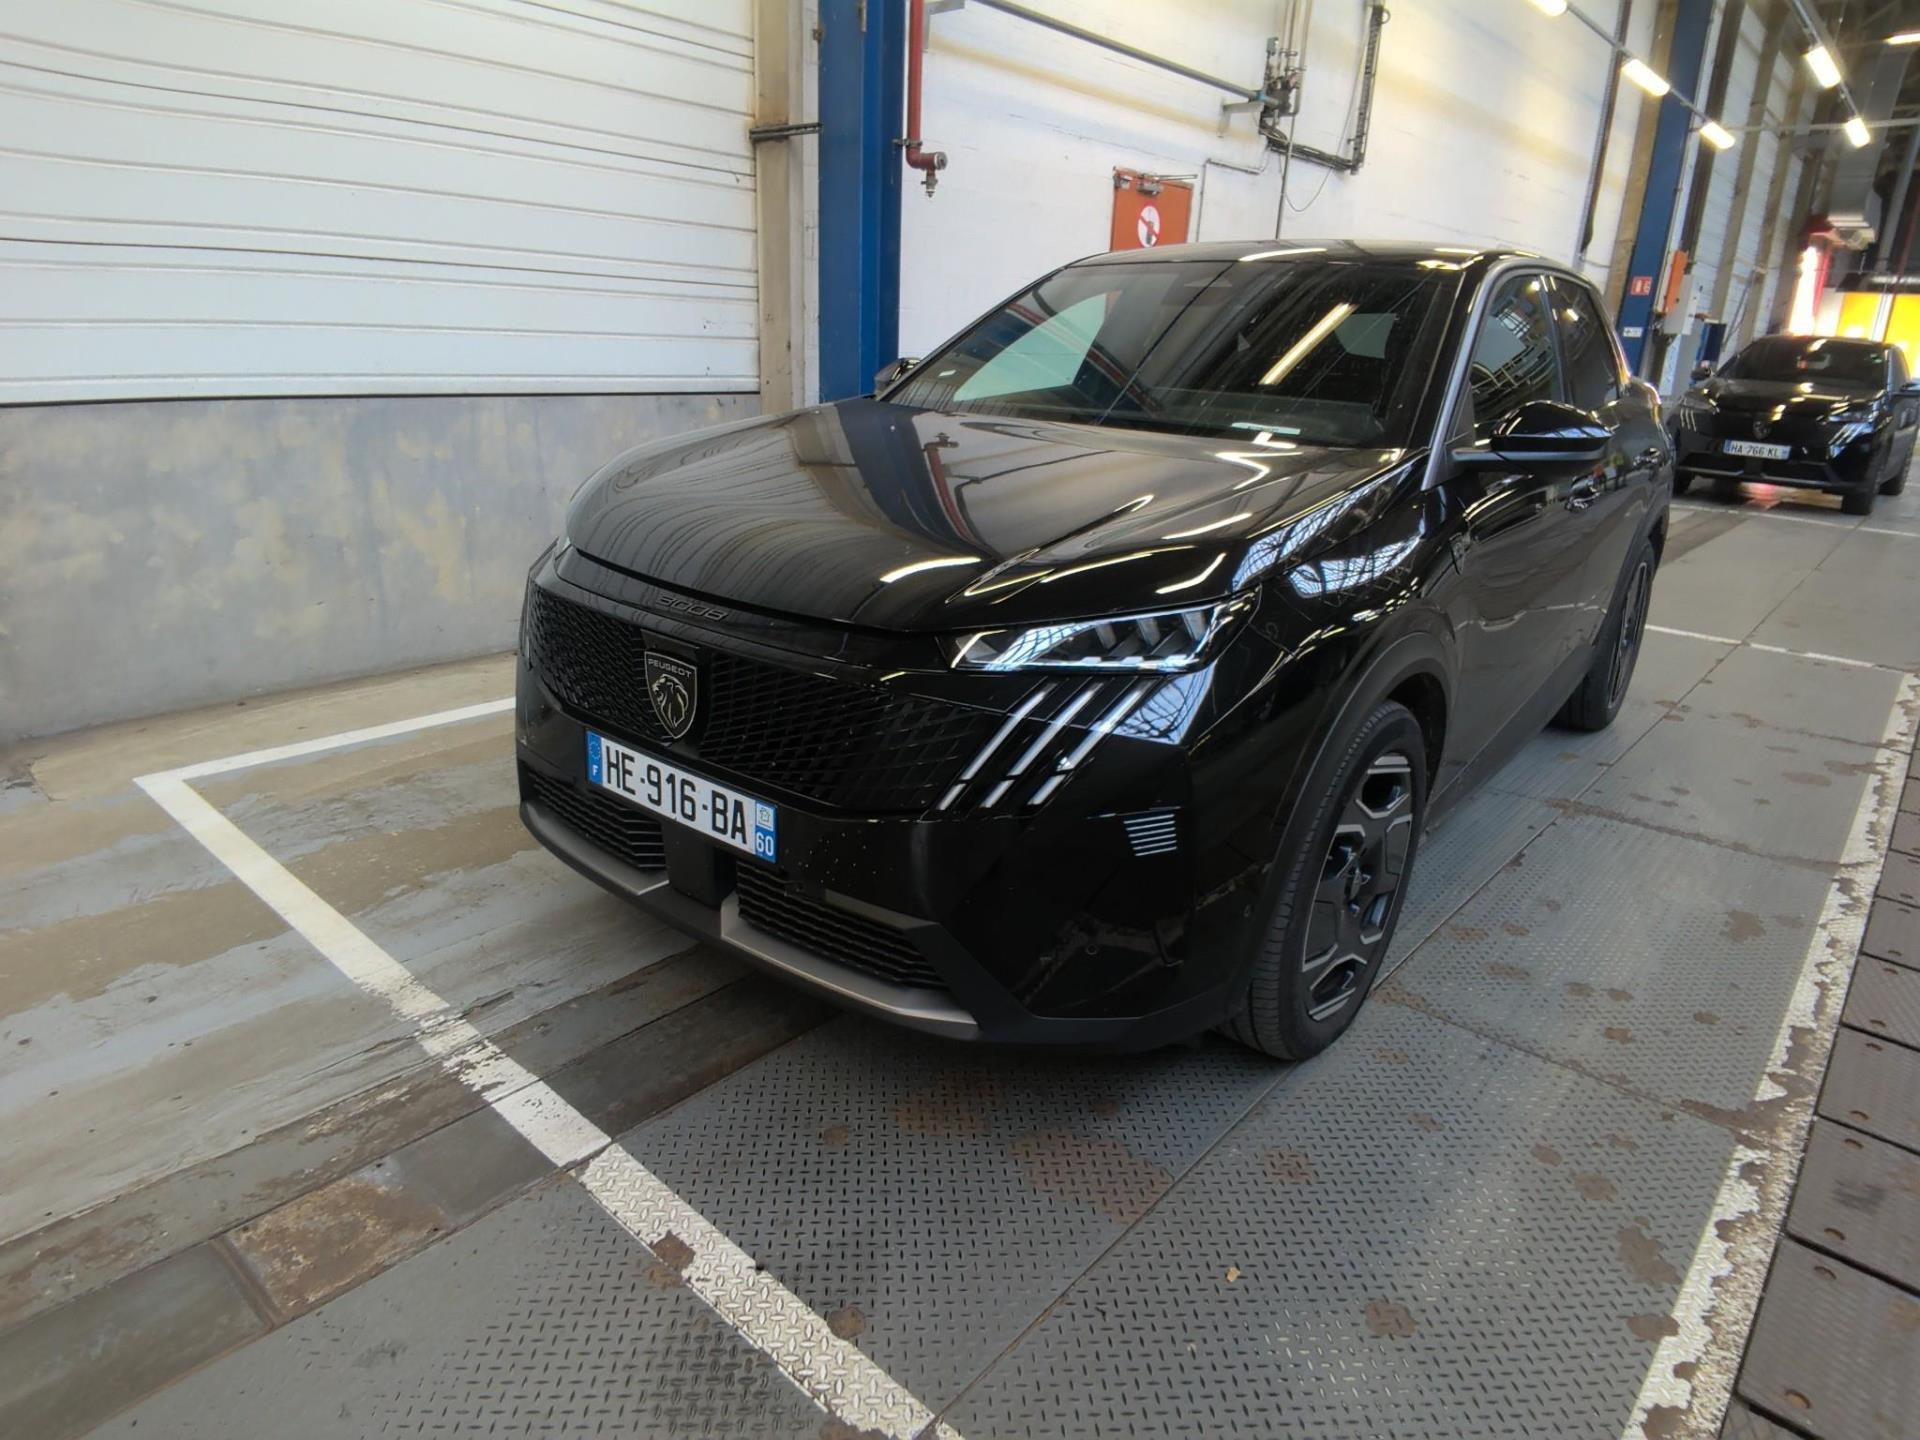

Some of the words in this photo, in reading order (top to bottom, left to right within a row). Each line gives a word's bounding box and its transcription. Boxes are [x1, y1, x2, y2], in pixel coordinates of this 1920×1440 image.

[656, 594, 728, 620] 3008
[648, 659, 692, 678] PEUGEOT
[592, 764, 599, 776] F
[756, 831, 774, 857] 60
